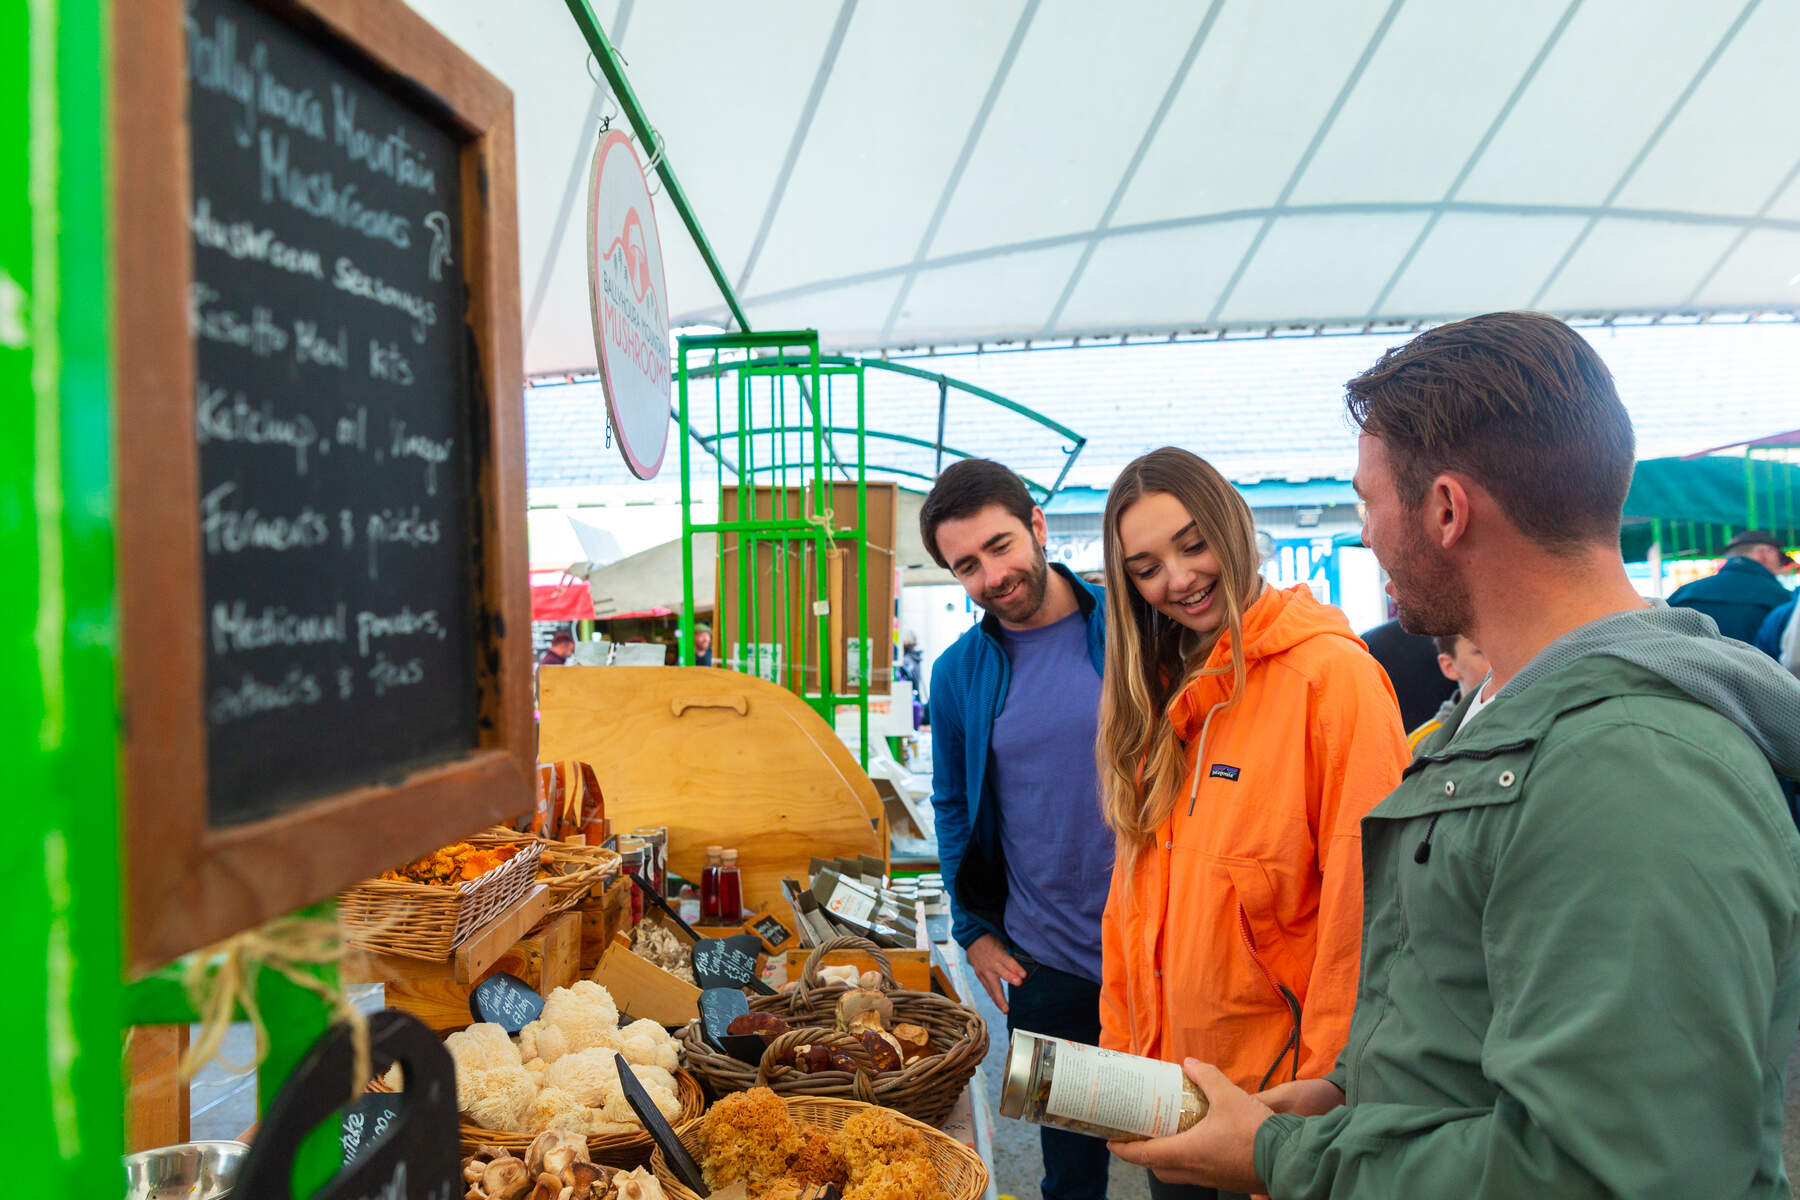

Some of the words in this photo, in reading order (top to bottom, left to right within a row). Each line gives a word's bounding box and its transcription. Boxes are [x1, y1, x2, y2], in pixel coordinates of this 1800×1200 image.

[331, 82, 436, 195] Mountain
[369, 337, 415, 386] Kits
[603, 294, 669, 397] MUSHROOMS
[212, 600, 348, 655] Medicinal
